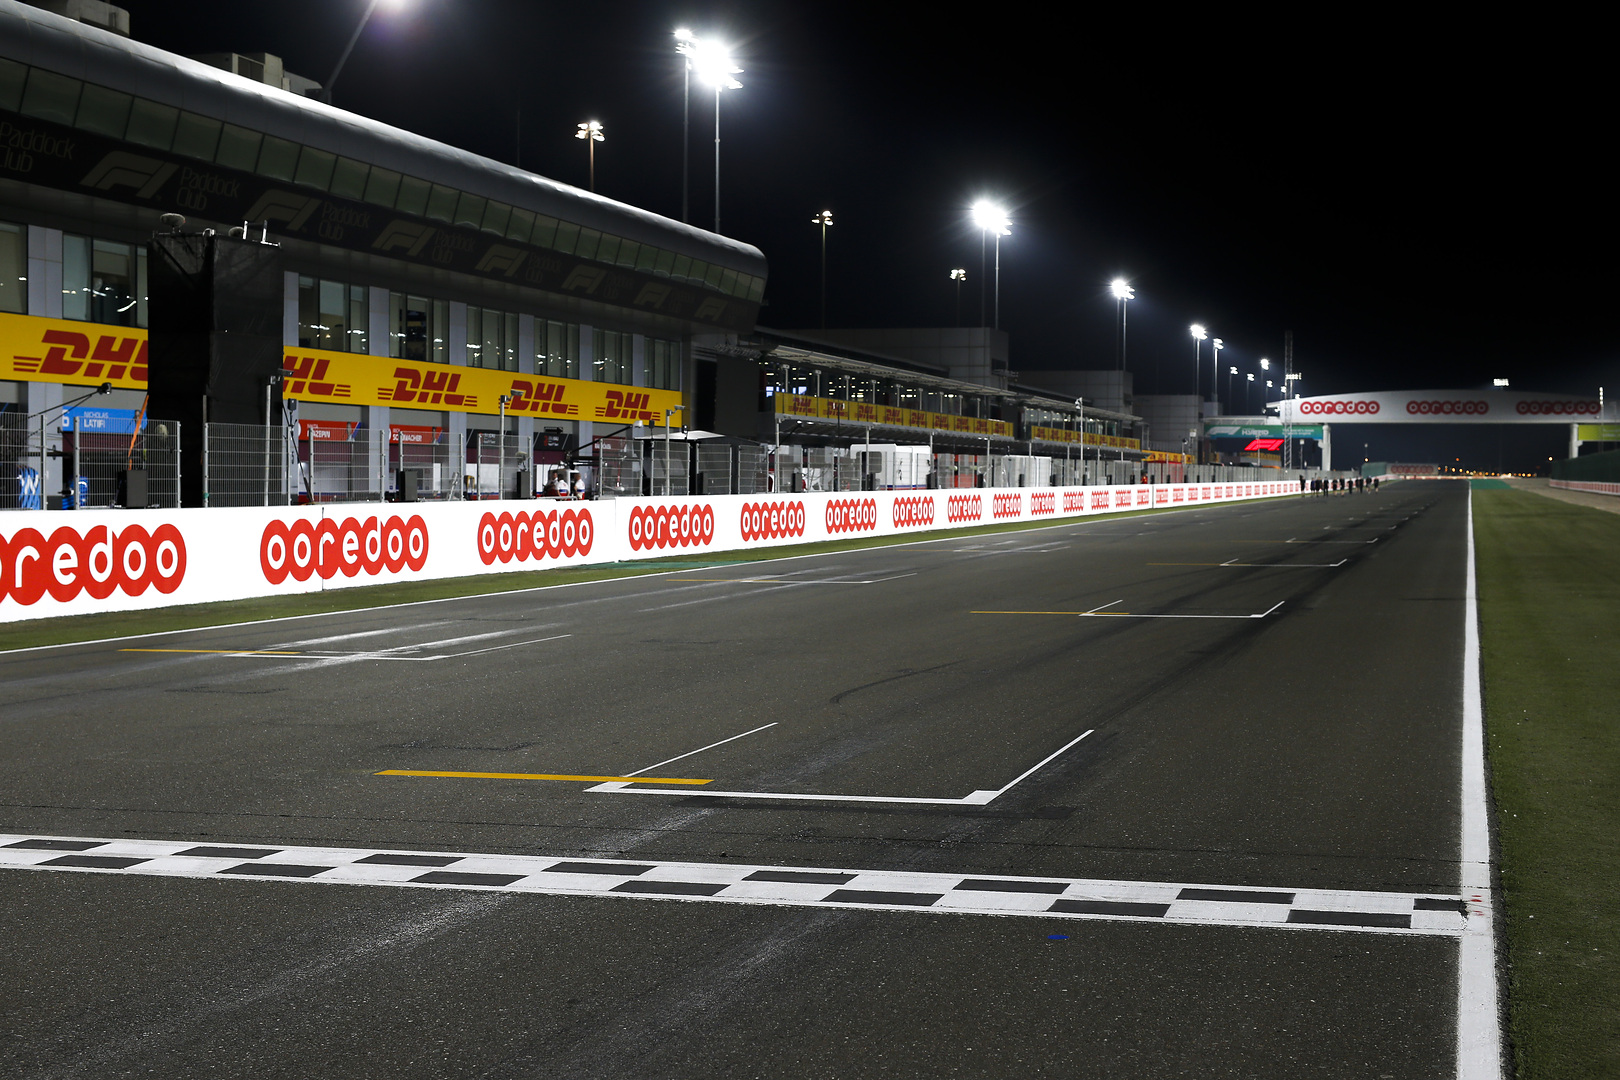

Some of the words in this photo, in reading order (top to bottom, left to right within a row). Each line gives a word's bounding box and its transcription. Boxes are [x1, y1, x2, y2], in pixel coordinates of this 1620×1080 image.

[0, 121, 75, 160] Paddock
[177, 185, 207, 212] Club
[181, 167, 240, 199] Paddock
[318, 220, 343, 241] Club
[322, 201, 370, 229] Paddock
[283, 356, 338, 396] HL
[389, 367, 467, 406] DHL
[503, 379, 571, 414] DHL
[602, 390, 654, 421] DHL
[1301, 401, 1379, 414] ooredoo
[1406, 401, 1488, 414] ooredoo
[1516, 401, 1600, 414] ooredoo
[741, 501, 804, 538] ooredoo
[826, 498, 876, 531] ooredoo
[893, 496, 934, 526] ooredoo
[948, 494, 981, 521] ooredoo
[993, 493, 1021, 518] ooredoo
[479, 508, 592, 560] ooredoo
[630, 504, 713, 547] ooredoo
[0, 525, 183, 597] redoo
[264, 515, 427, 578] ooredoo
